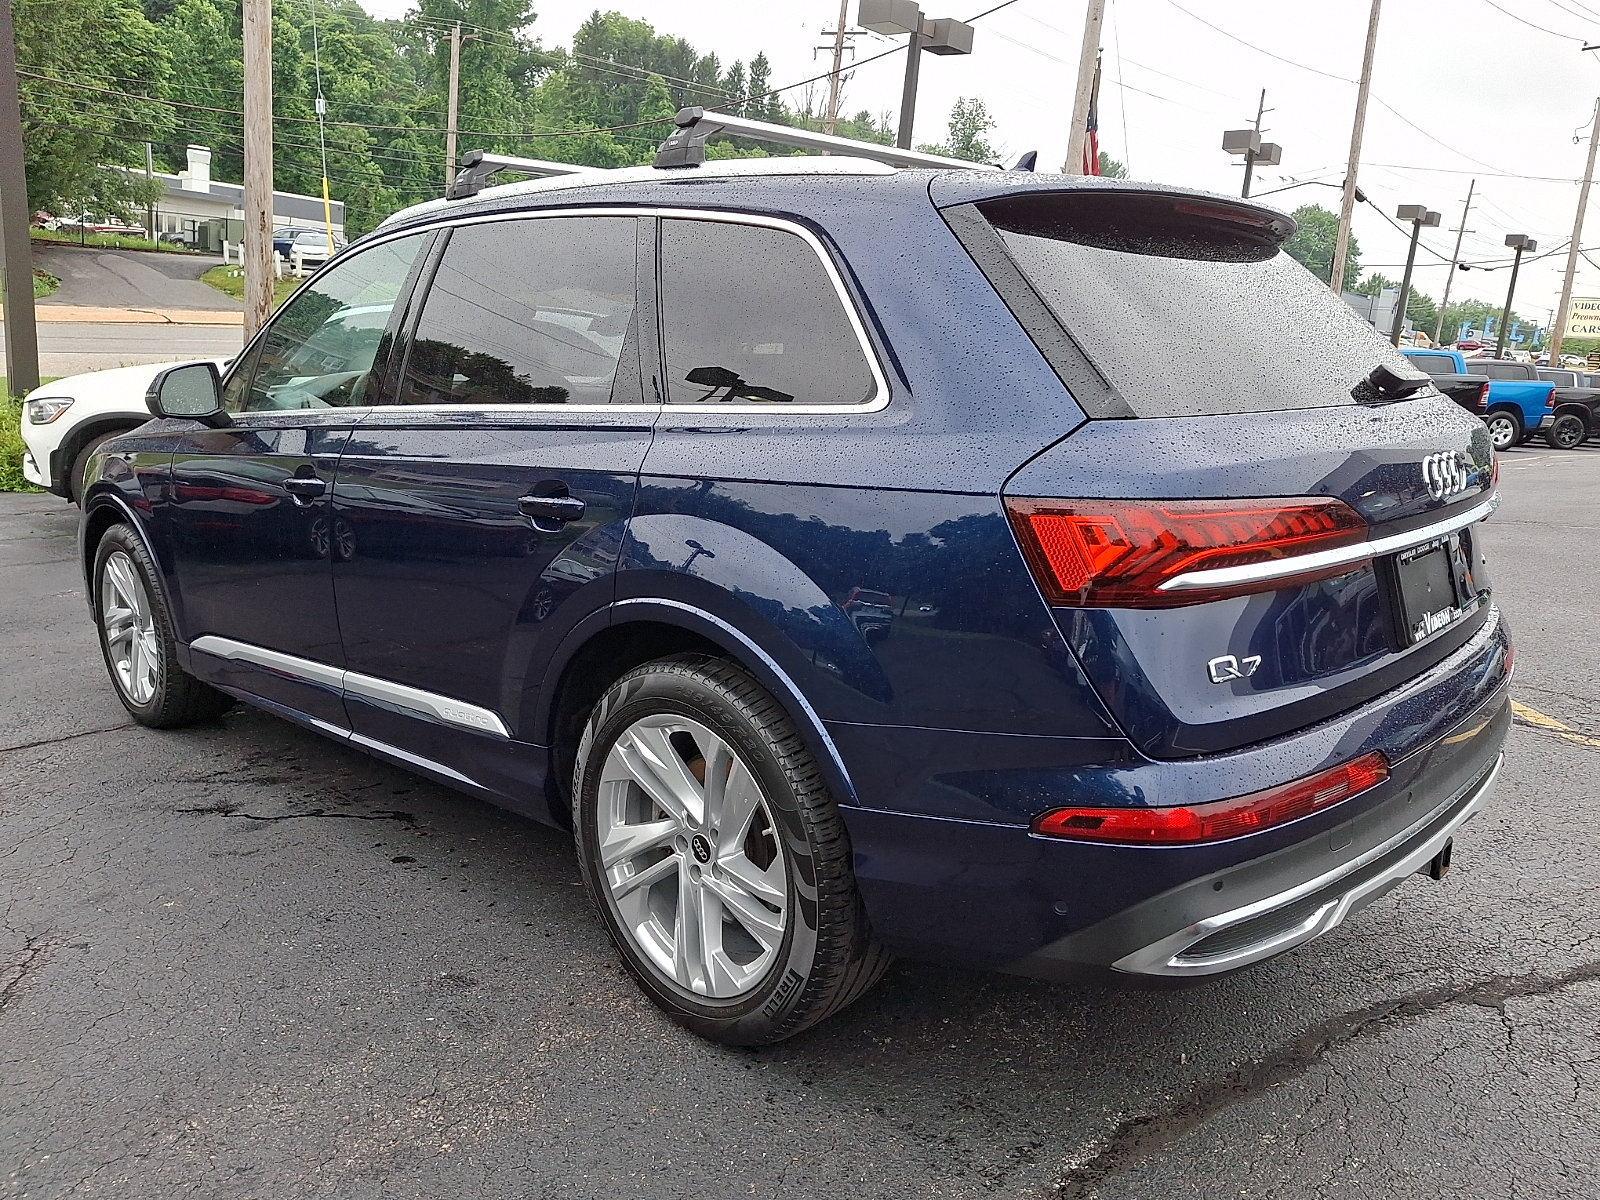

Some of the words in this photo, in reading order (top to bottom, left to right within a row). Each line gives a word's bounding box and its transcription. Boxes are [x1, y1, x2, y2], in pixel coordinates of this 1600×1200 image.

[1571, 312, 1600, 321] Preown
[1207, 654, 1262, 684] Q7
[762, 967, 805, 1018] PIRELLI
